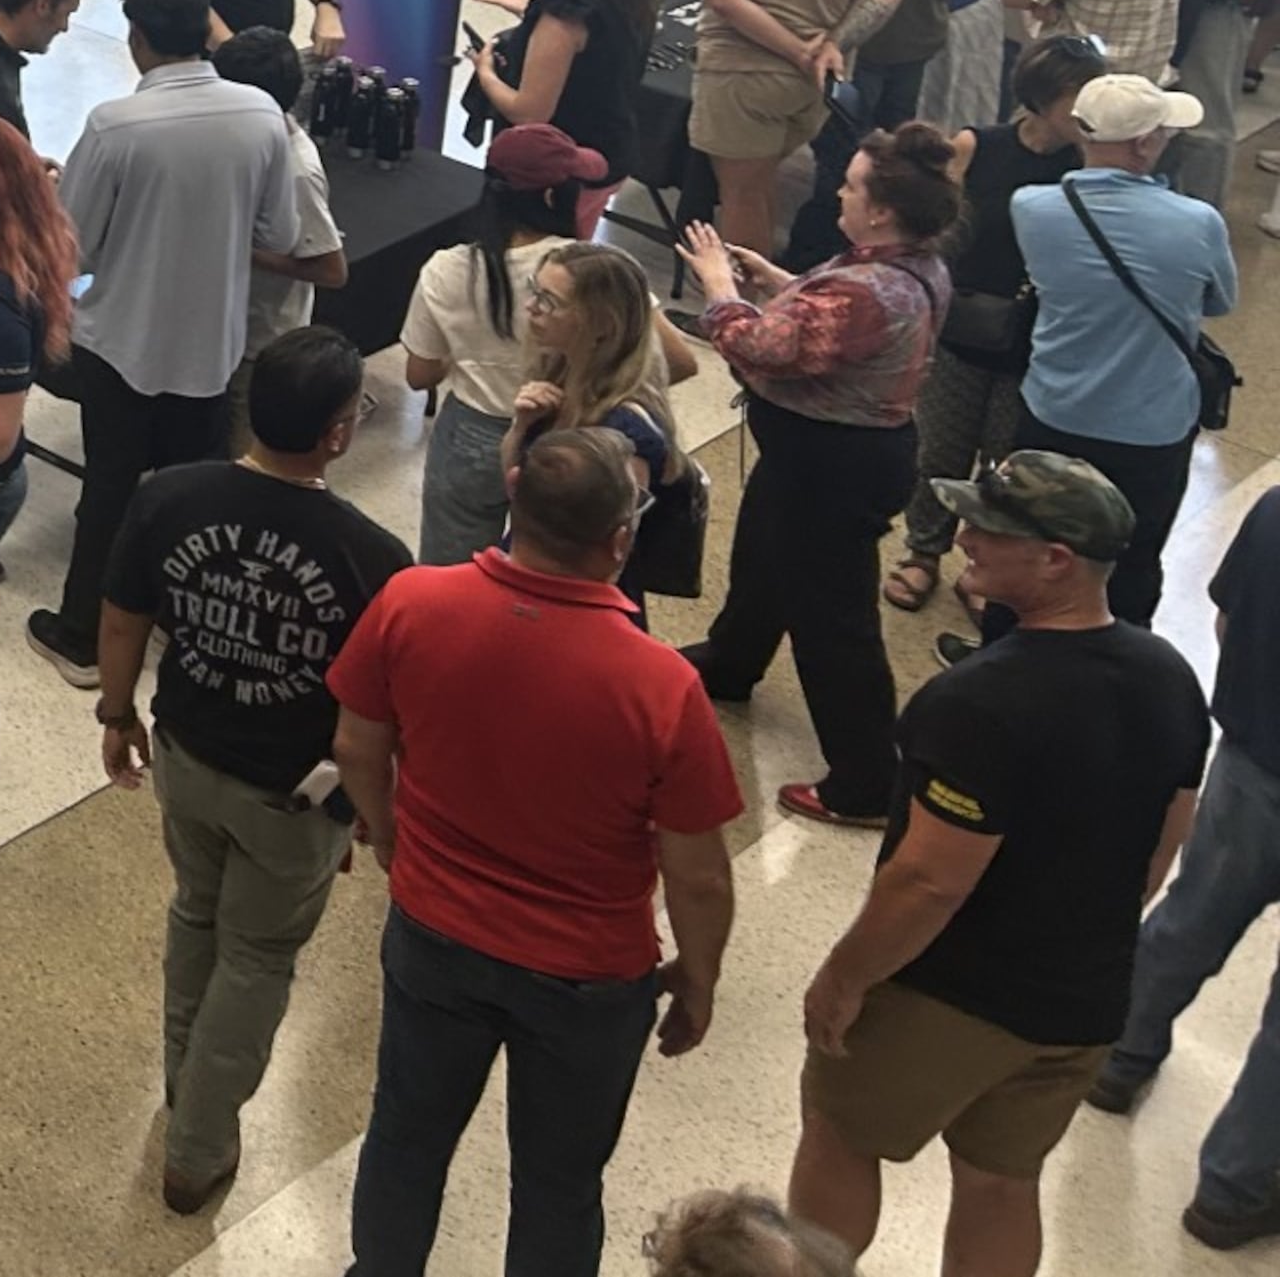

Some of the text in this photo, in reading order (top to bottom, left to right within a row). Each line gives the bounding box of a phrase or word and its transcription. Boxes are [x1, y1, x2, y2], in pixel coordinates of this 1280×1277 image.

[163, 524, 346, 623] DIRTY HANDS
[200, 572, 301, 619] MMXVII
[167, 586, 261, 646] TROLL
[174, 627, 323, 705] CEAN MONEY
[196, 631, 287, 674] CLOTHING
